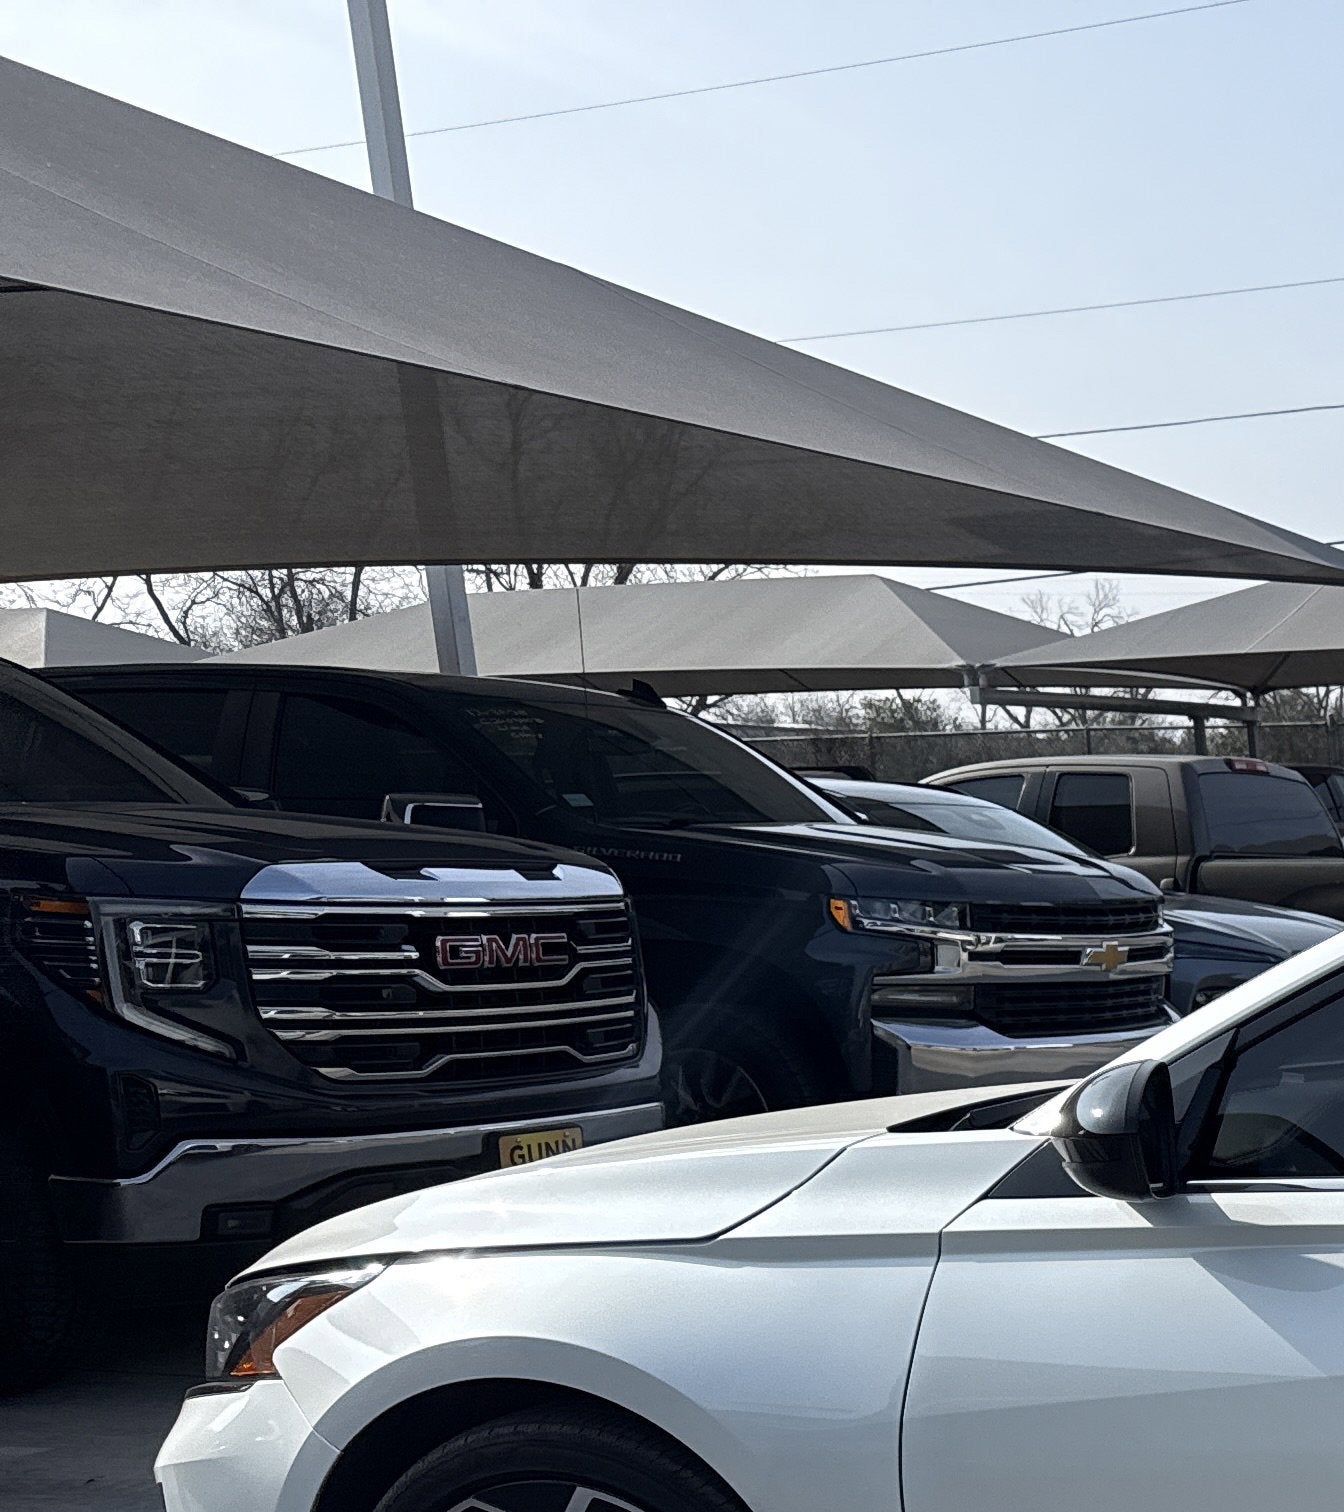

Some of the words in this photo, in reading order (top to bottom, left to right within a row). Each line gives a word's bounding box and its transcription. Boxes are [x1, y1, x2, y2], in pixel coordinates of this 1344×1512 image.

[574, 846, 683, 863] SILVERADO
[436, 933, 570, 969] GMC
[510, 1137, 578, 1166] GUNN
